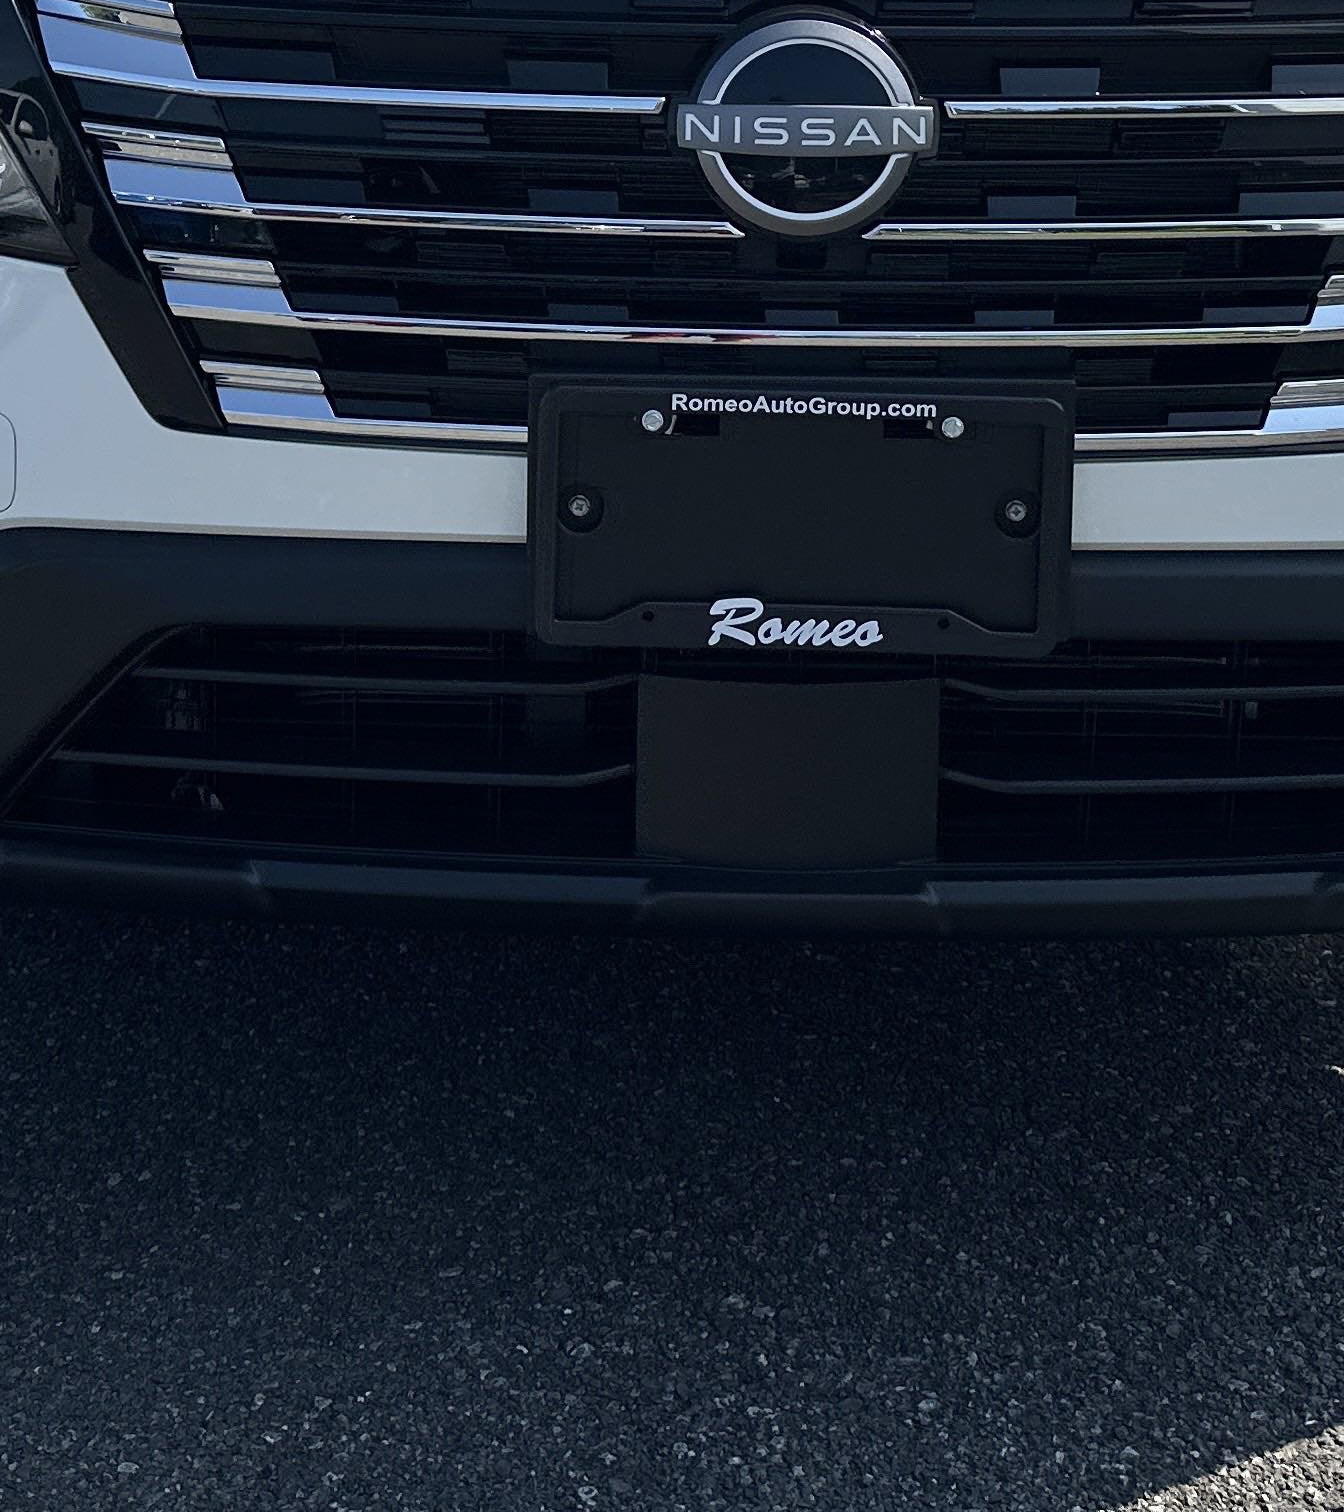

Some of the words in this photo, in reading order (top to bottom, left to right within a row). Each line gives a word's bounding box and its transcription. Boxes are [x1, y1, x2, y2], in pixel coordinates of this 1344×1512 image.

[685, 112, 926, 146] NISSAN
[671, 393, 937, 419] RomeoAutoGroup.com
[708, 597, 884, 647] Romeo
